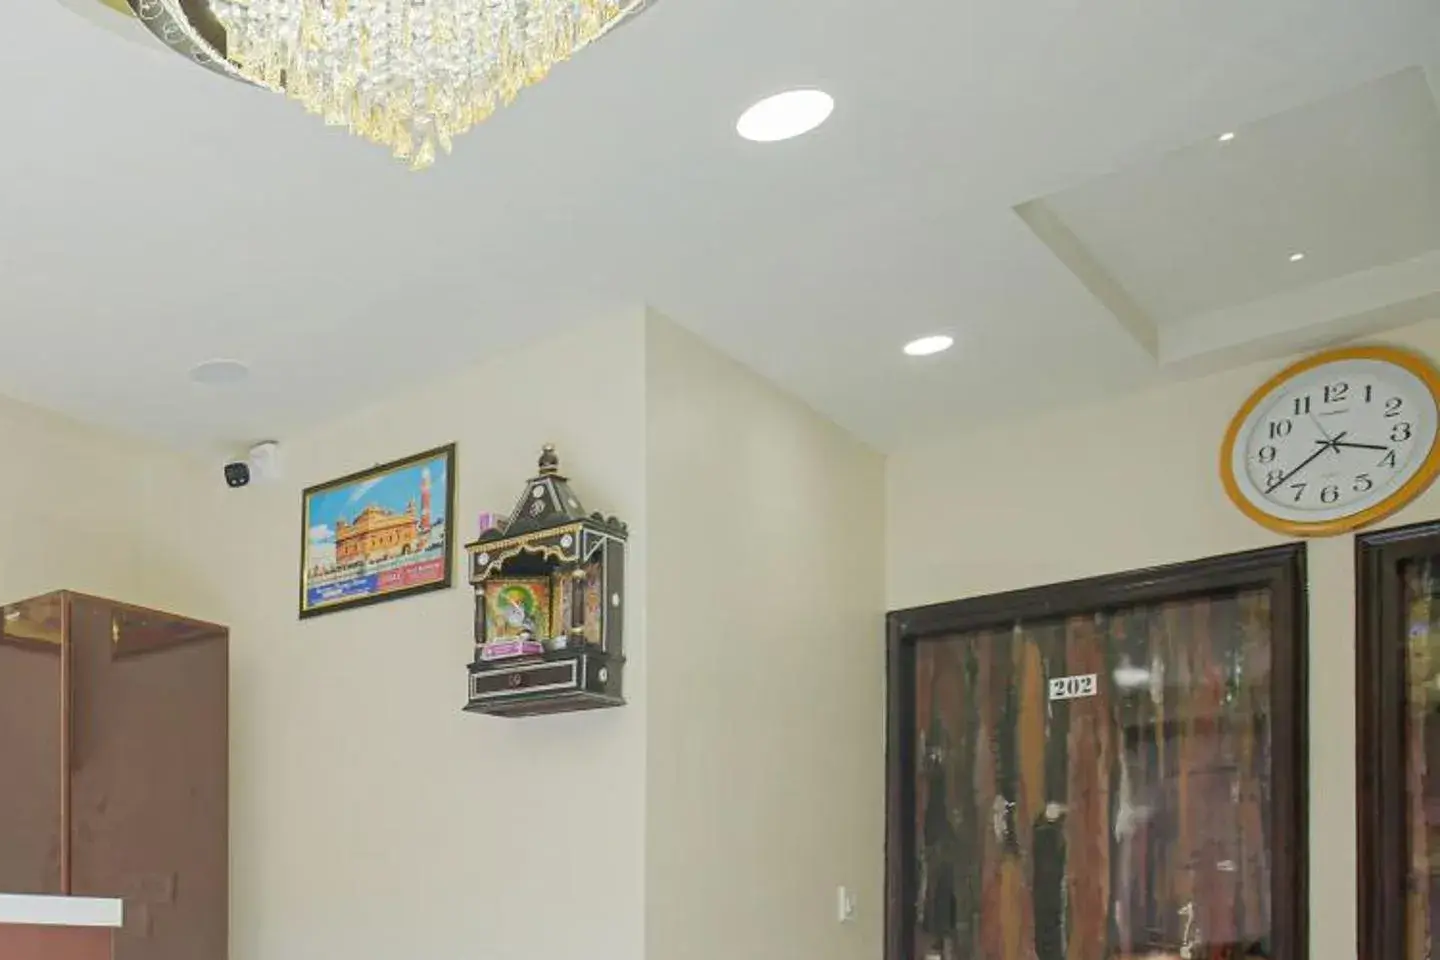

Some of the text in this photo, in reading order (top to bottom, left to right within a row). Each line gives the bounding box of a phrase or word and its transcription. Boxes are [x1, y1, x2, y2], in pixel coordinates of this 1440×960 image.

[1323, 382, 1349, 404] 12
[1364, 384, 1372, 403] 1
[1293, 396, 1310, 415] 11
[1384, 397, 1402, 418] 2
[1269, 419, 1292, 439] 10
[1390, 422, 1411, 442] 3
[1259, 445, 1276, 463] 9
[1377, 449, 1396, 468] 4
[1266, 469, 1284, 488] 8
[1353, 473, 1372, 492] 5
[1290, 483, 1307, 502] 7
[1320, 485, 1339, 503] 6
[1054, 677, 1092, 696] 202
